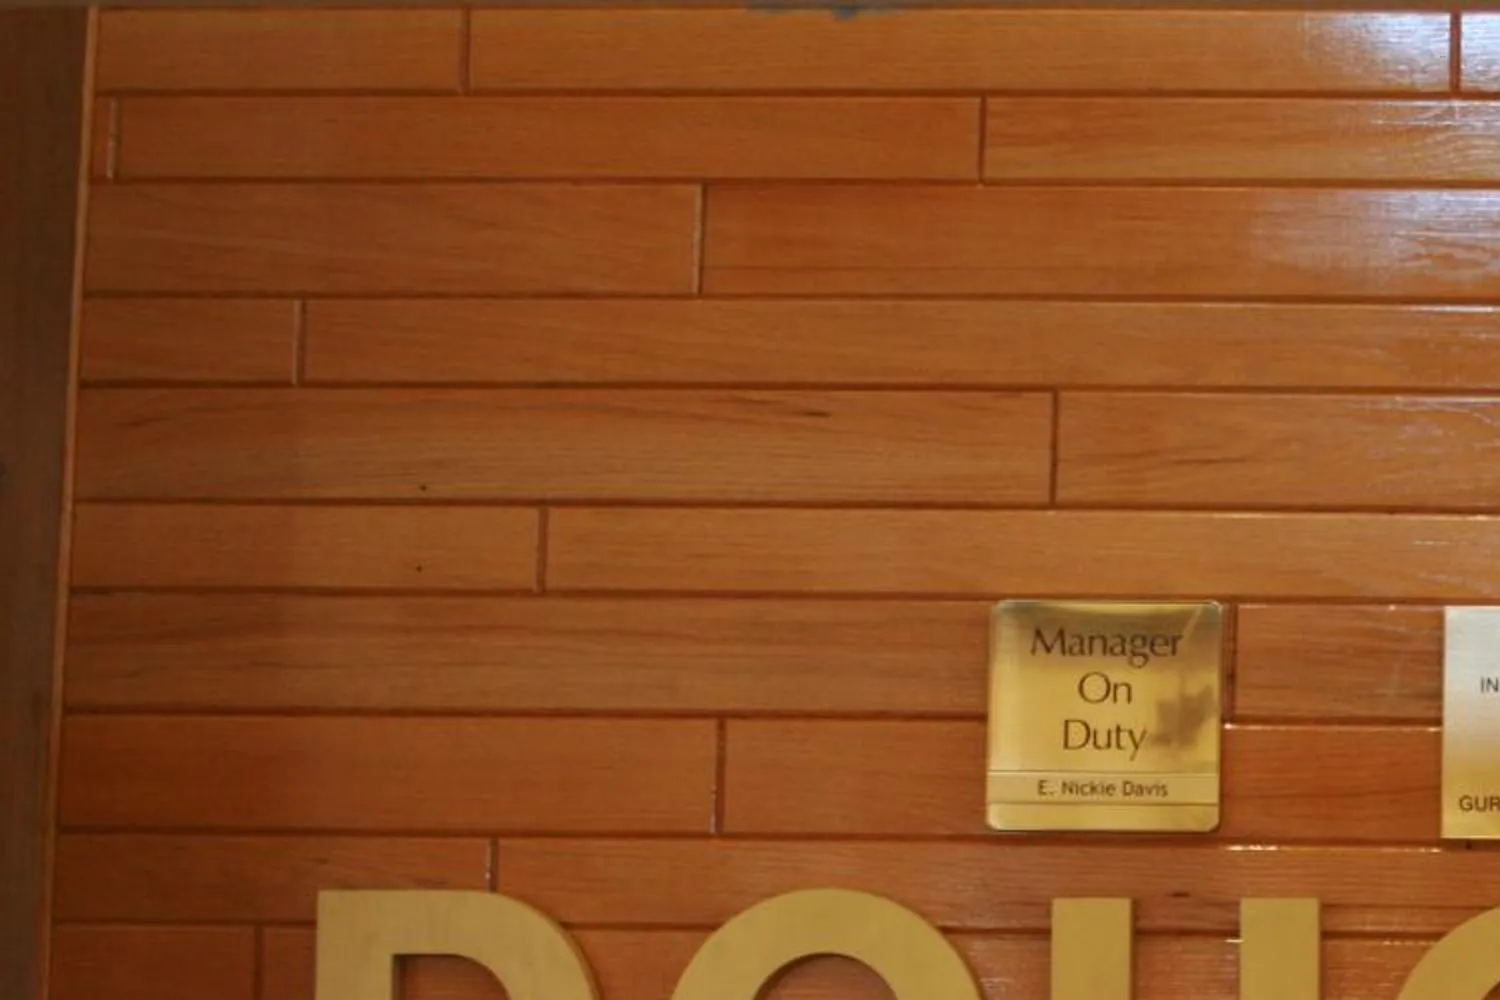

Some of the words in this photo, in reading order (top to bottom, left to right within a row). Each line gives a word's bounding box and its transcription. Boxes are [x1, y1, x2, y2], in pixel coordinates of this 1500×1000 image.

[1030, 626, 1183, 669] Manager
[1078, 671, 1133, 704] On
[1062, 719, 1148, 762] Duty
[1037, 779, 1054, 796] E.
[1061, 780, 1116, 797] Nickie
[1122, 780, 1168, 797] Davis
